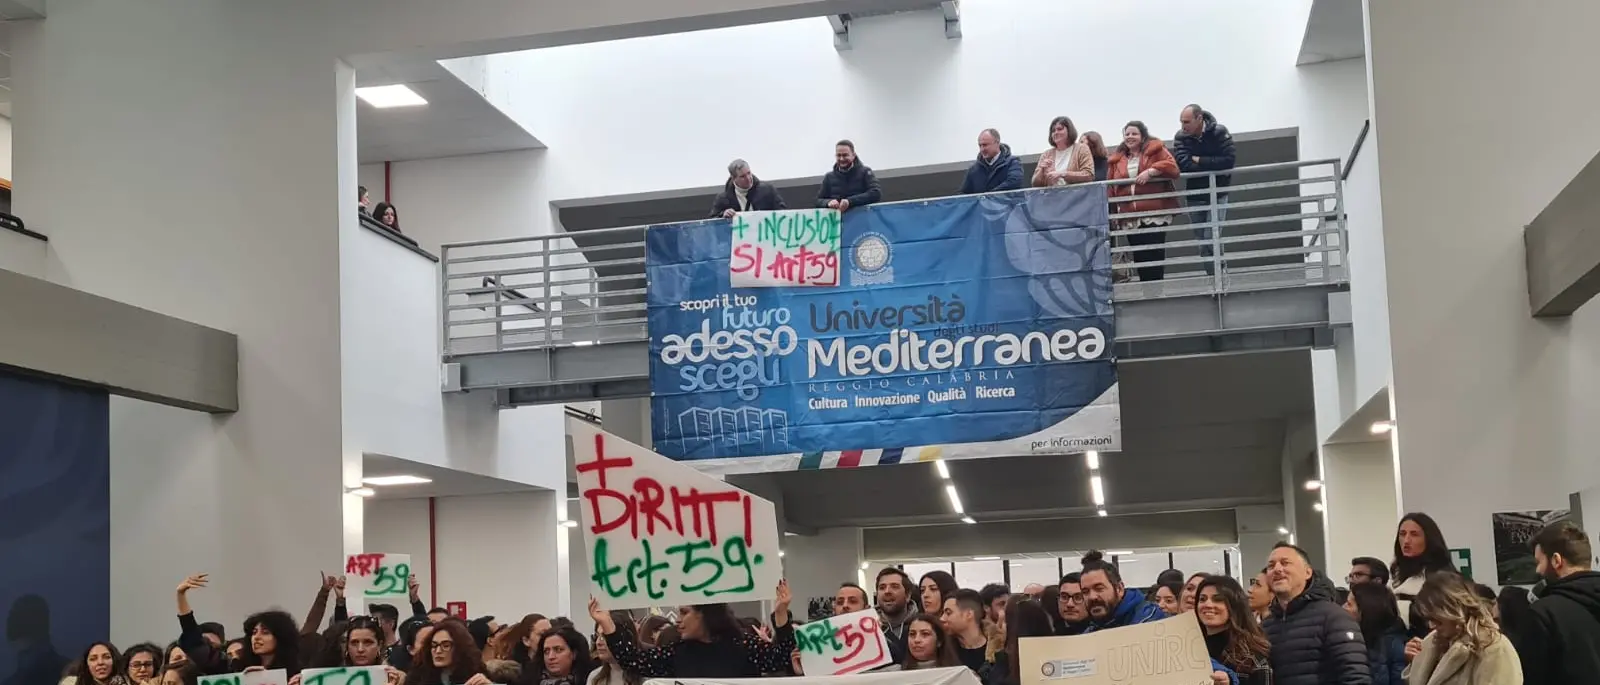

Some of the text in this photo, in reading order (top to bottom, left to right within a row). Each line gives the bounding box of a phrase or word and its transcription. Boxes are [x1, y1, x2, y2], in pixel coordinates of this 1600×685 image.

[731, 244, 763, 279] SI
[680, 294, 757, 314] scopri il tuo
[722, 306, 791, 329] futuro
[809, 293, 966, 333] Università
[661, 318, 798, 365] adesso
[968, 321, 1000, 334] studi
[808, 326, 1106, 379] Mediterranea
[680, 348, 781, 401] scegli
[808, 370, 1015, 393] REGGIO CALABRIA
[808, 386, 1016, 410] Cultura Innovazione Qualità Ricerca
[576, 434, 633, 489] +
[1031, 435, 1112, 451] per informazioni
[584, 477, 752, 548] DIRITTI
[346, 553, 410, 596] ART 59
[833, 616, 884, 676] 59
